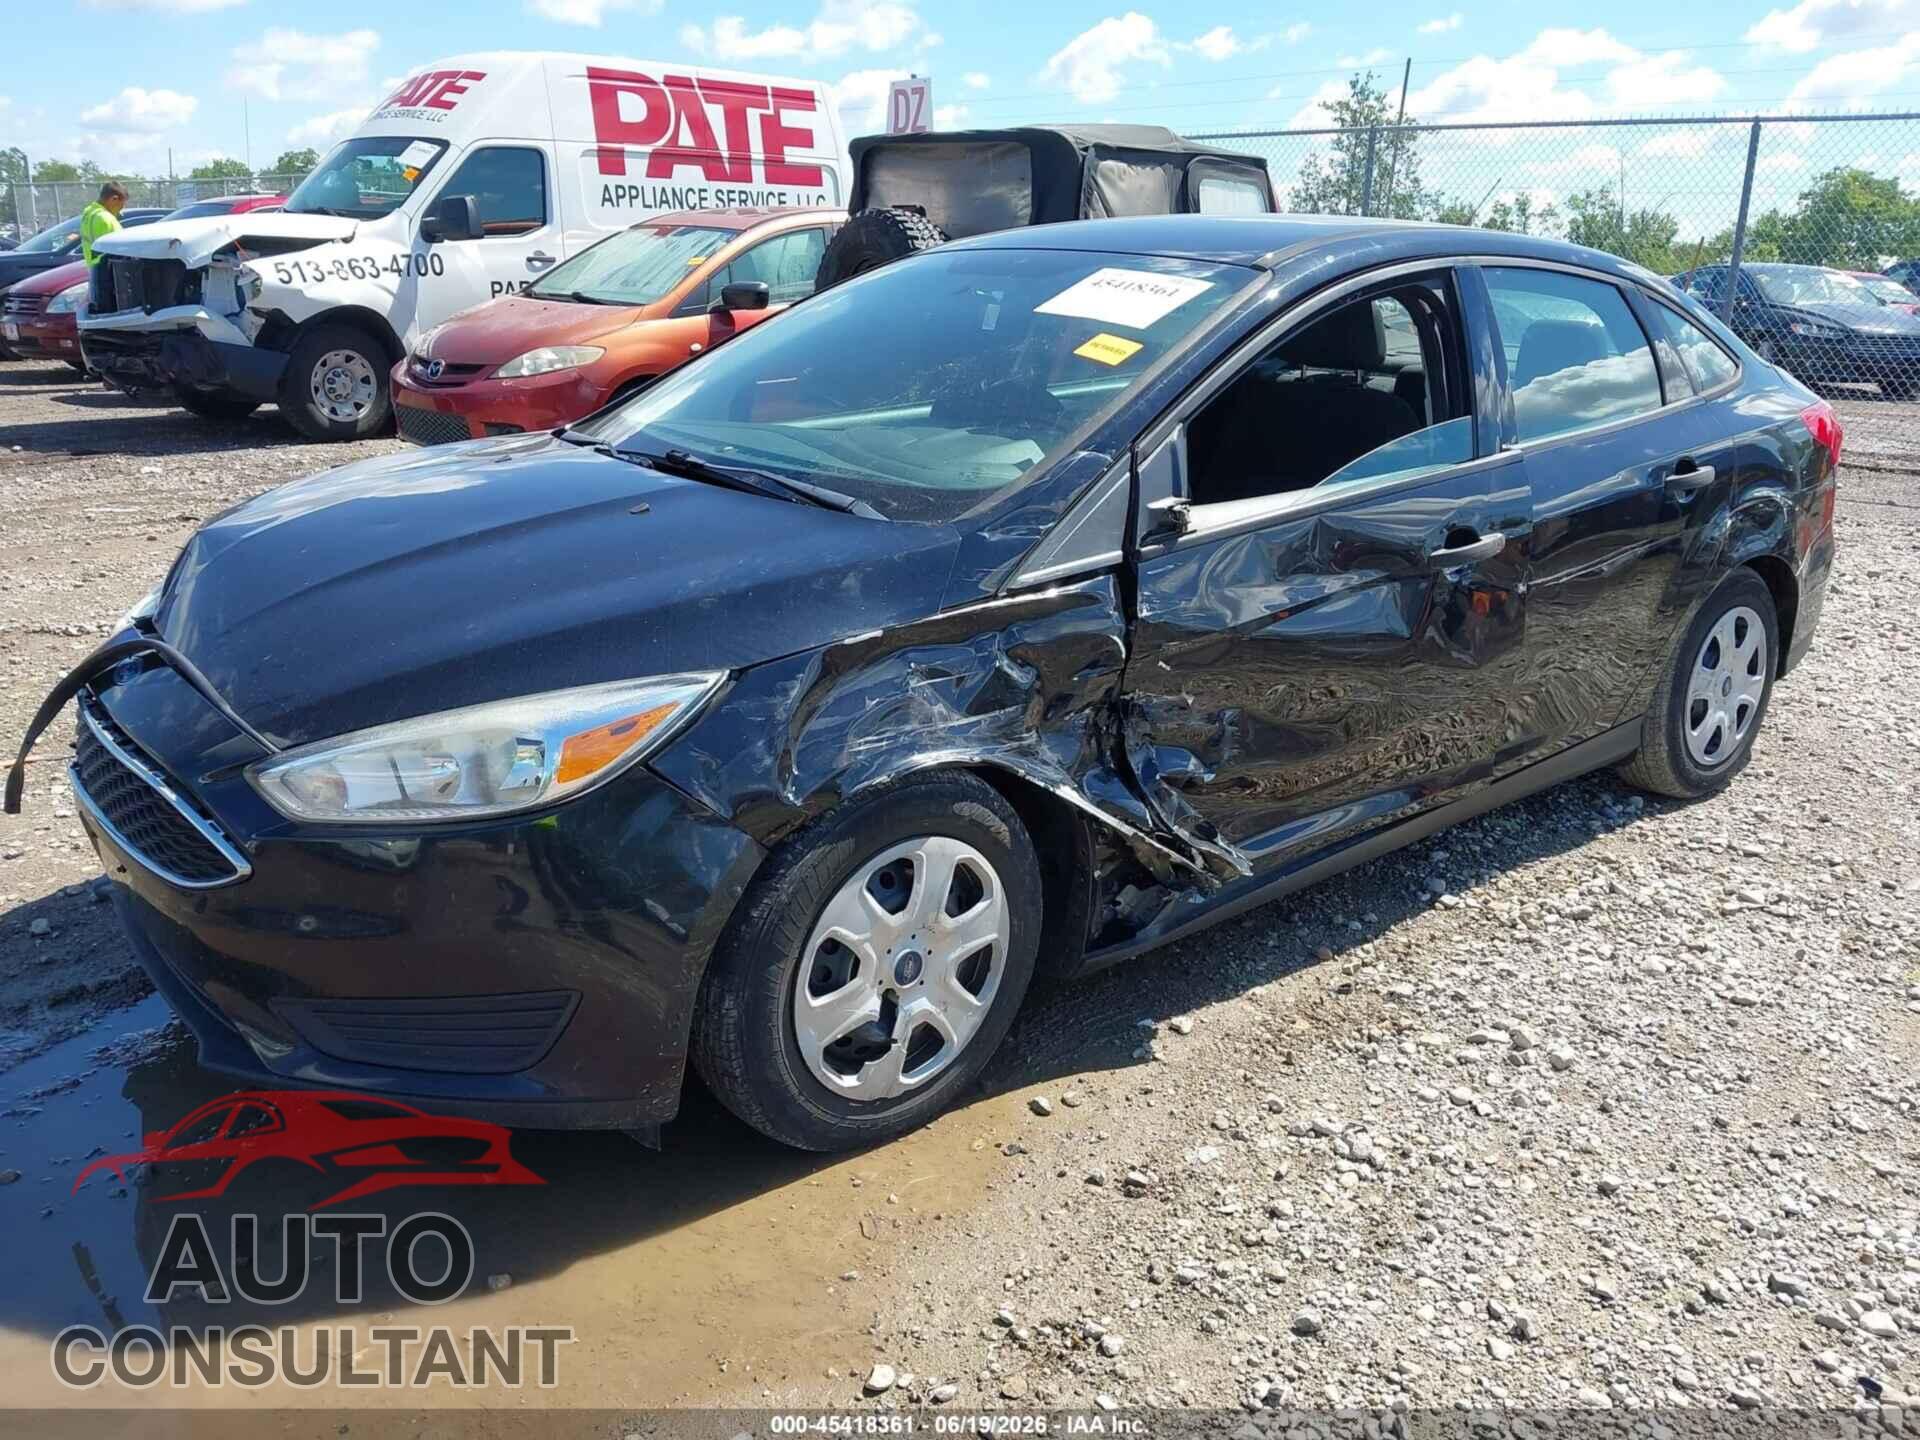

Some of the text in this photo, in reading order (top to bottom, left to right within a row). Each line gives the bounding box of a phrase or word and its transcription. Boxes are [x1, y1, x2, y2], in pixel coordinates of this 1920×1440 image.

[586, 66, 823, 187] PATE
[893, 86, 929, 132] DZ
[601, 183, 709, 210] APPLIANCE
[715, 188, 787, 208] SERVICE
[274, 252, 445, 285] 513-863-4700
